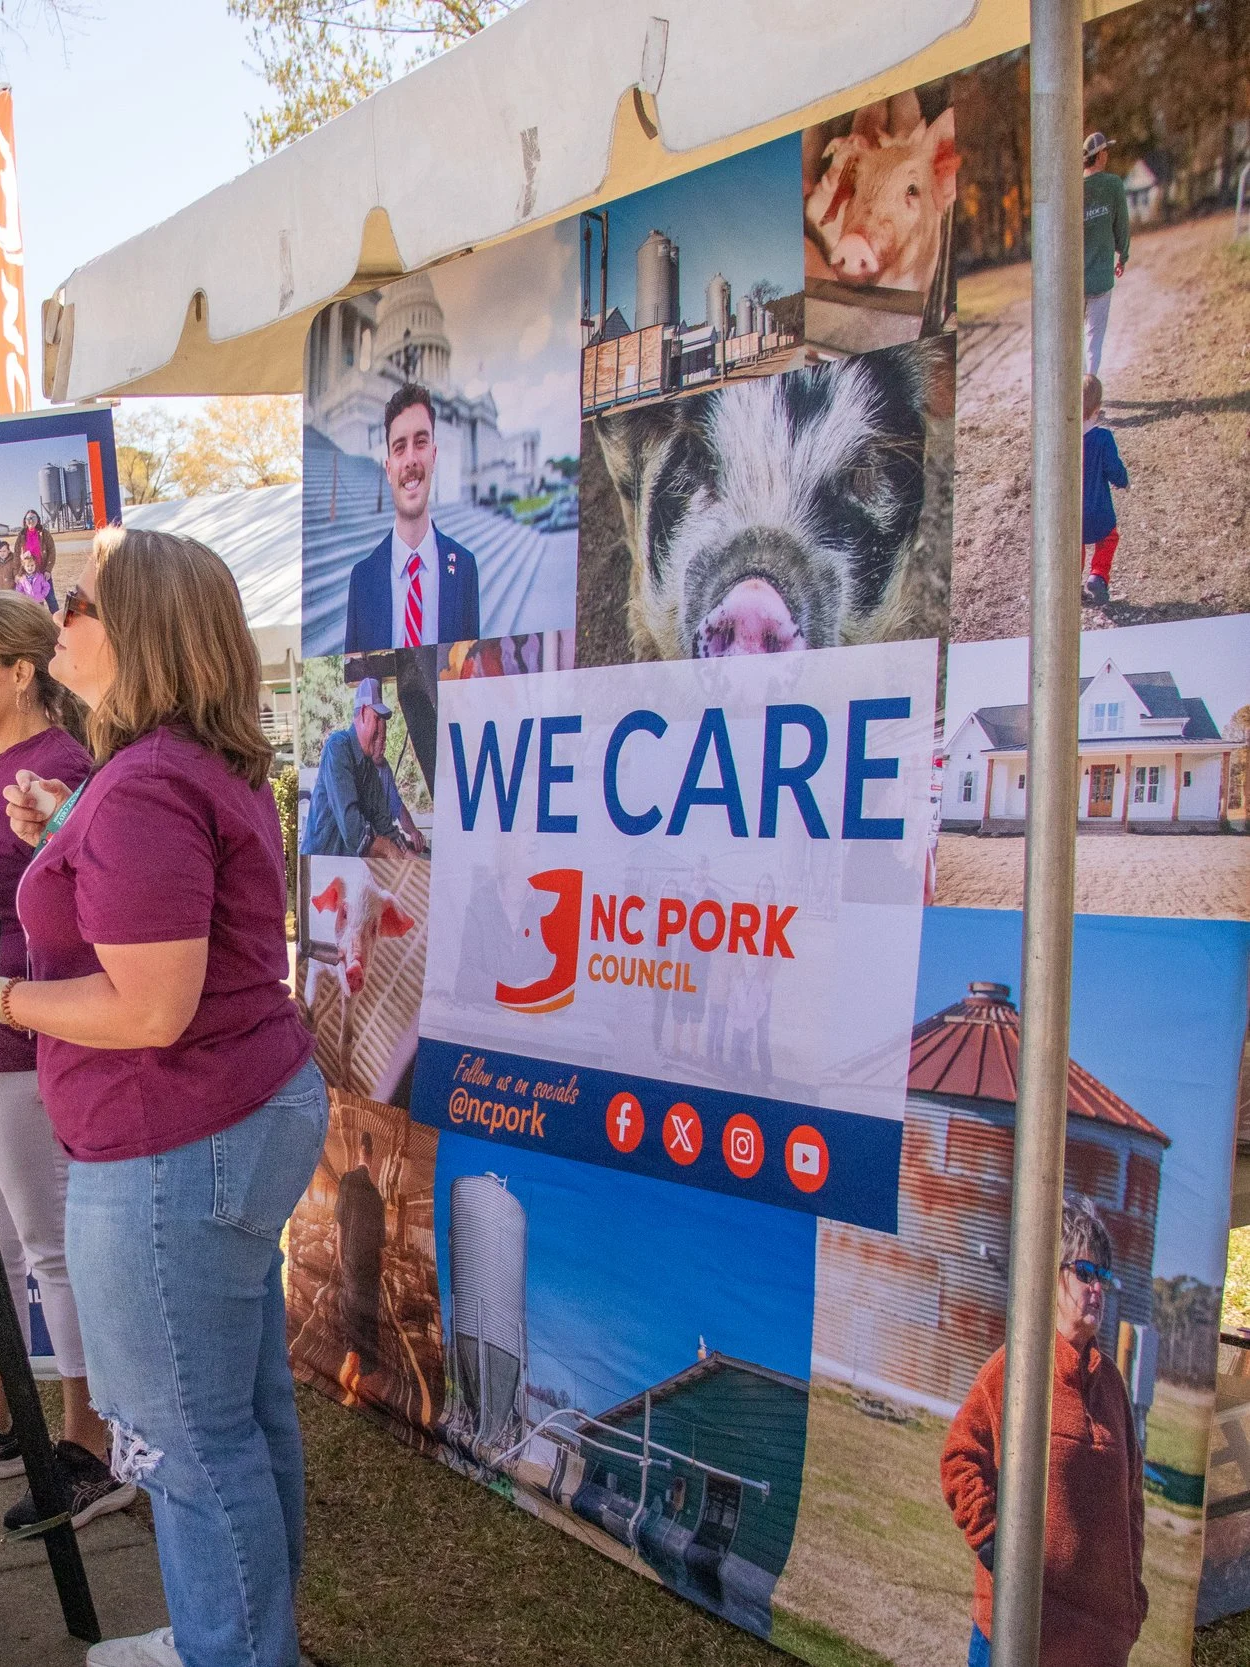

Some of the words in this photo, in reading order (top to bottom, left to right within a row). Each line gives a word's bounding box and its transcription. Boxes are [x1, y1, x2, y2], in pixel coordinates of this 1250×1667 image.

[448, 715, 582, 833] WE
[603, 696, 911, 840] CARE
[590, 894, 645, 945] NC
[656, 897, 798, 959] PORK
[587, 953, 697, 994] COUNCIL
[453, 1053, 493, 1087] Follow
[496, 1075, 512, 1091] us
[514, 1078, 530, 1096] on
[532, 1074, 580, 1105] socials
[449, 1087, 547, 1138] @ncpork
